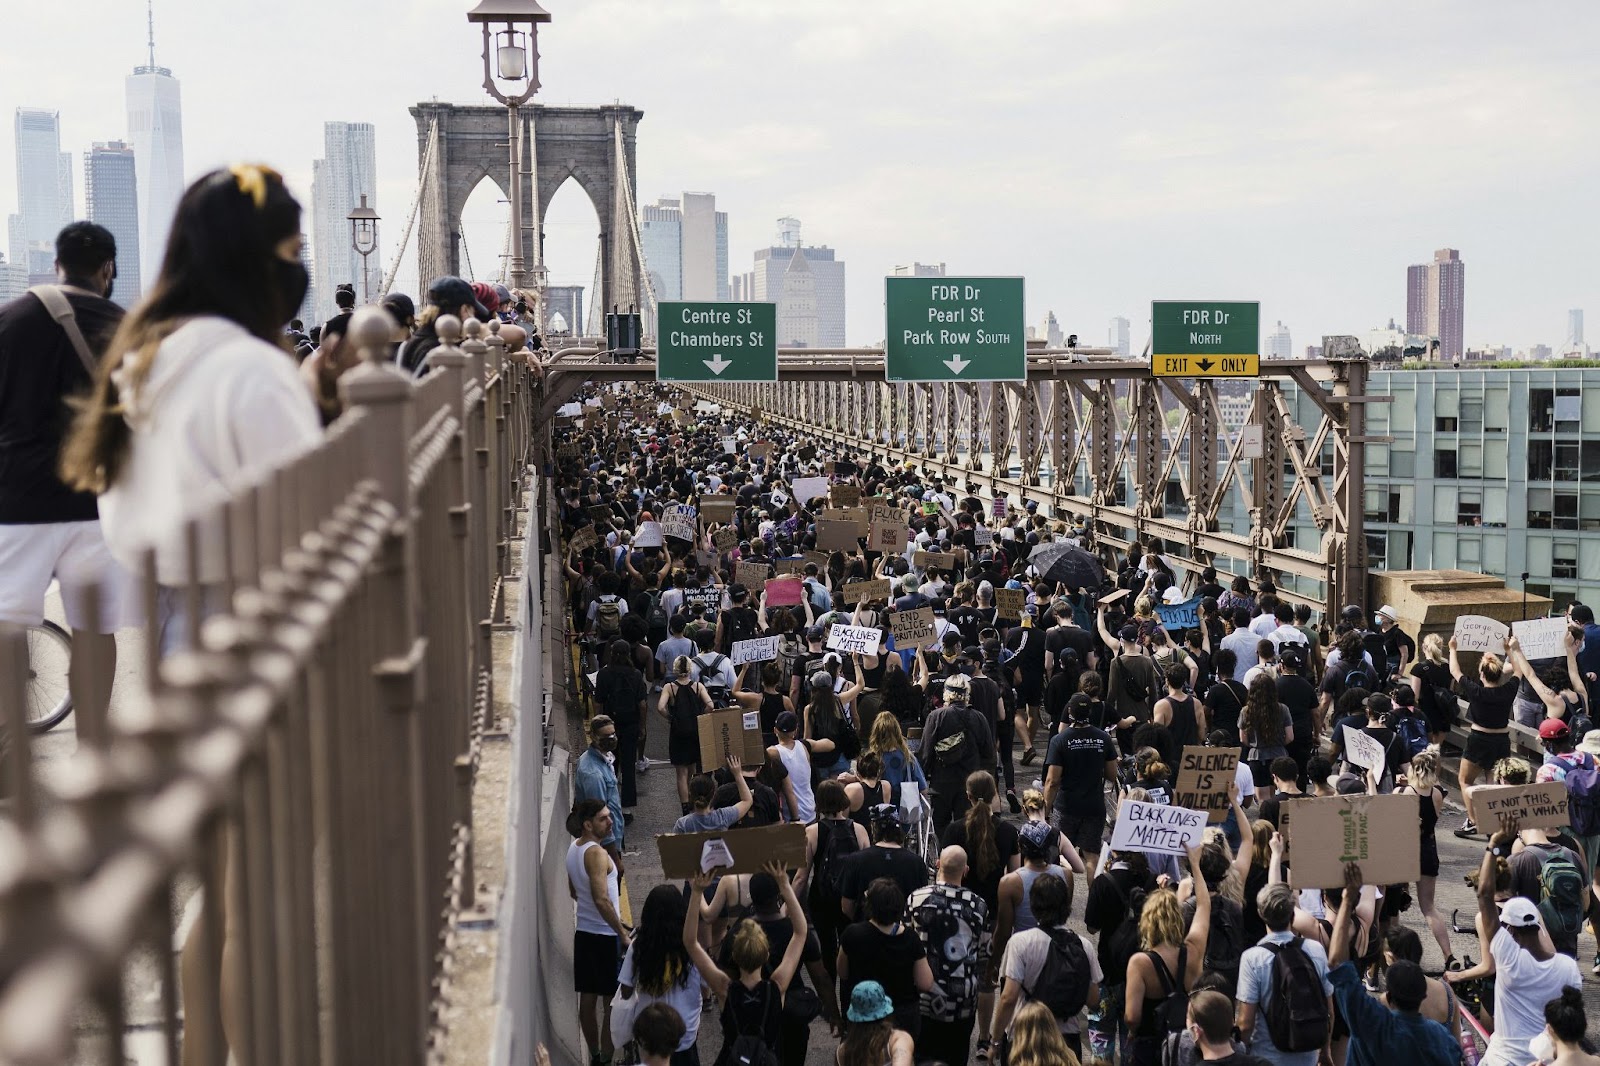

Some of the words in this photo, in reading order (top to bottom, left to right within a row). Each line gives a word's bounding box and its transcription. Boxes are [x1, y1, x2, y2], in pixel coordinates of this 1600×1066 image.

[931, 285, 959, 301] FDR
[964, 285, 980, 301] Dr
[682, 308, 731, 324] Centre
[737, 308, 752, 324] St
[928, 307, 964, 323] Pearl
[969, 307, 984, 322] St
[1183, 310, 1209, 325] FDR
[1215, 310, 1230, 325] Dr
[670, 331, 743, 347] Chambers
[749, 331, 764, 347] St
[903, 329, 934, 345] Park
[940, 329, 971, 344] Row
[1190, 332, 1222, 345] NORTH
[1165, 358, 1188, 372] EXIT
[1221, 358, 1248, 372] ONLY
[875, 506, 906, 524] BLACK
[737, 563, 767, 571] JUSTICE
[687, 594, 719, 602] MURDERS
[900, 611, 920, 623] END
[833, 625, 856, 640] BLACK
[856, 630, 878, 642] LIVES
[893, 620, 927, 633] POLICE
[1462, 617, 1492, 635] George
[893, 628, 934, 643] BRUTALITY
[1461, 633, 1490, 649] Floyd
[837, 636, 869, 654] MATTER
[1183, 753, 1236, 771] SILENCE
[1196, 774, 1214, 790] IS
[1176, 791, 1229, 811] VIOLENCE
[1487, 800, 1498, 810] IF
[1501, 796, 1520, 808] NOT
[1129, 803, 1162, 824] BLACK
[1168, 810, 1201, 827] LIVES
[1494, 807, 1528, 821] THEN
[1128, 825, 1191, 849] MATTER
[1360, 837, 1368, 859] DISH
